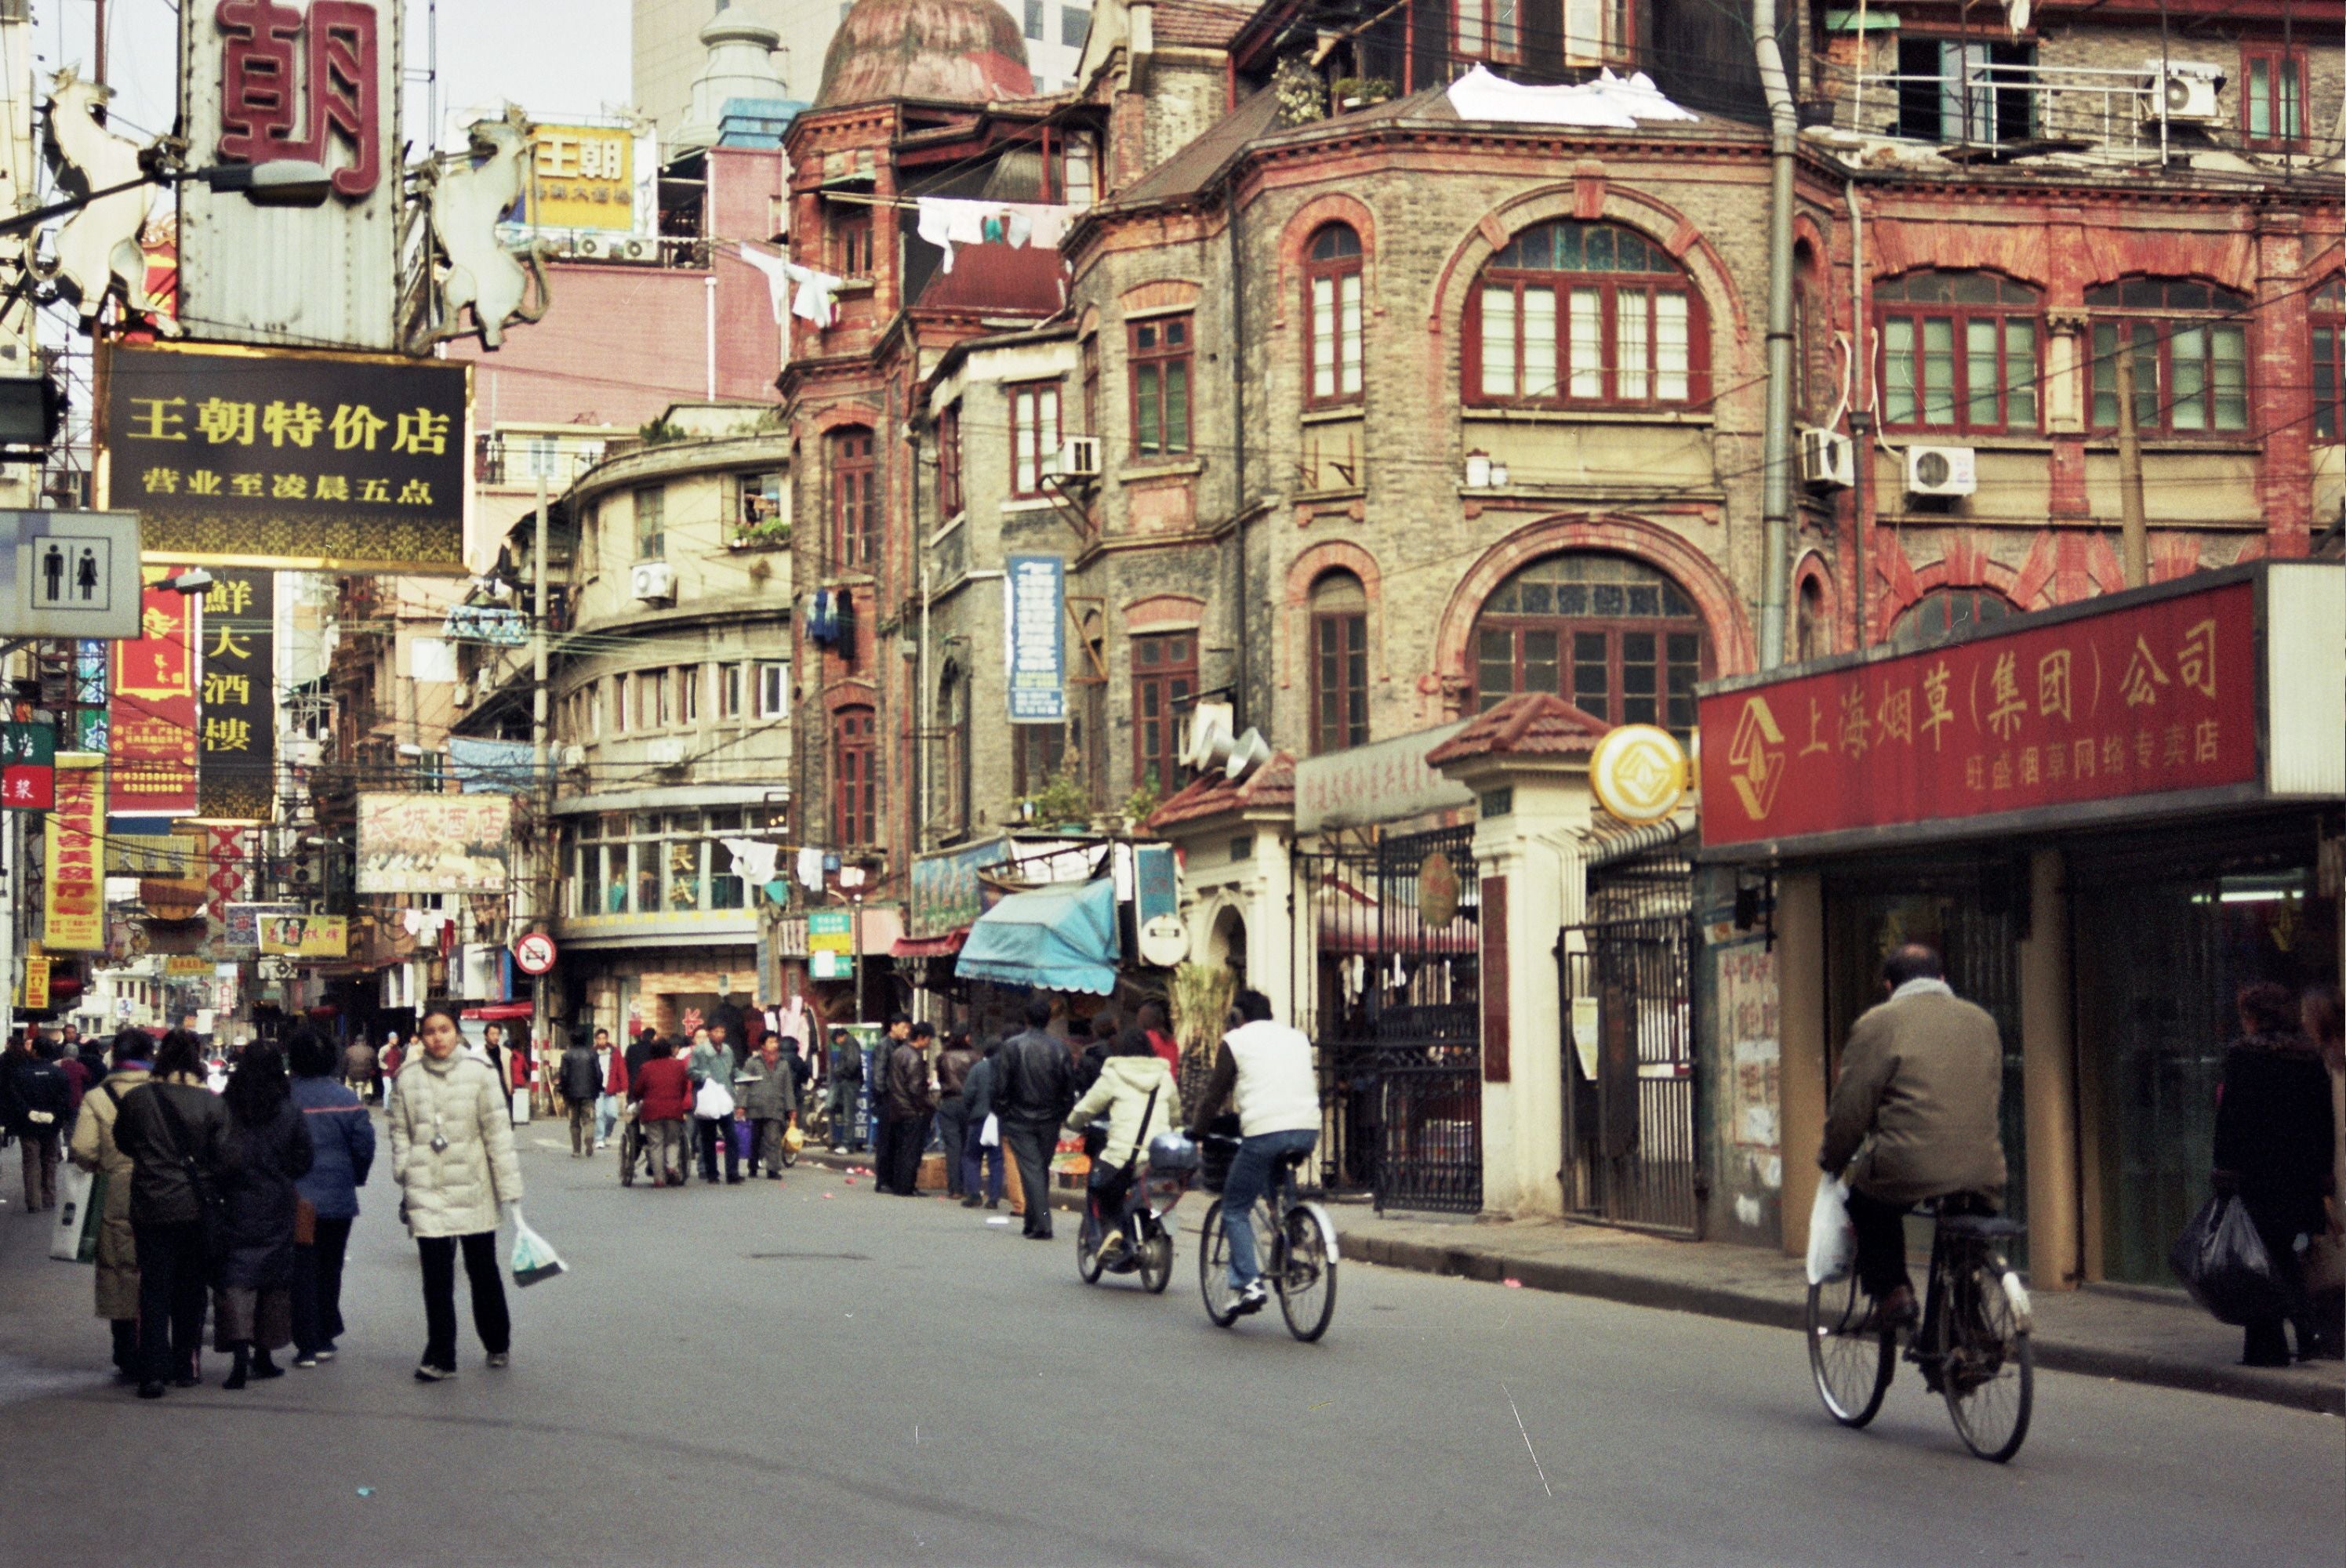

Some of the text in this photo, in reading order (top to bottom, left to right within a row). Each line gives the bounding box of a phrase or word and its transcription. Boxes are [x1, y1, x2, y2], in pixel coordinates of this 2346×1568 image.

[215, 0, 380, 196] 朝
[537, 134, 623, 180] 王朝
[126, 397, 452, 456] 王朝特价店
[142, 467, 433, 506] 营业至凌晨五点
[202, 579, 253, 752] 鮮大酒樓
[1799, 619, 2217, 760] 上海烟草(集团)公司
